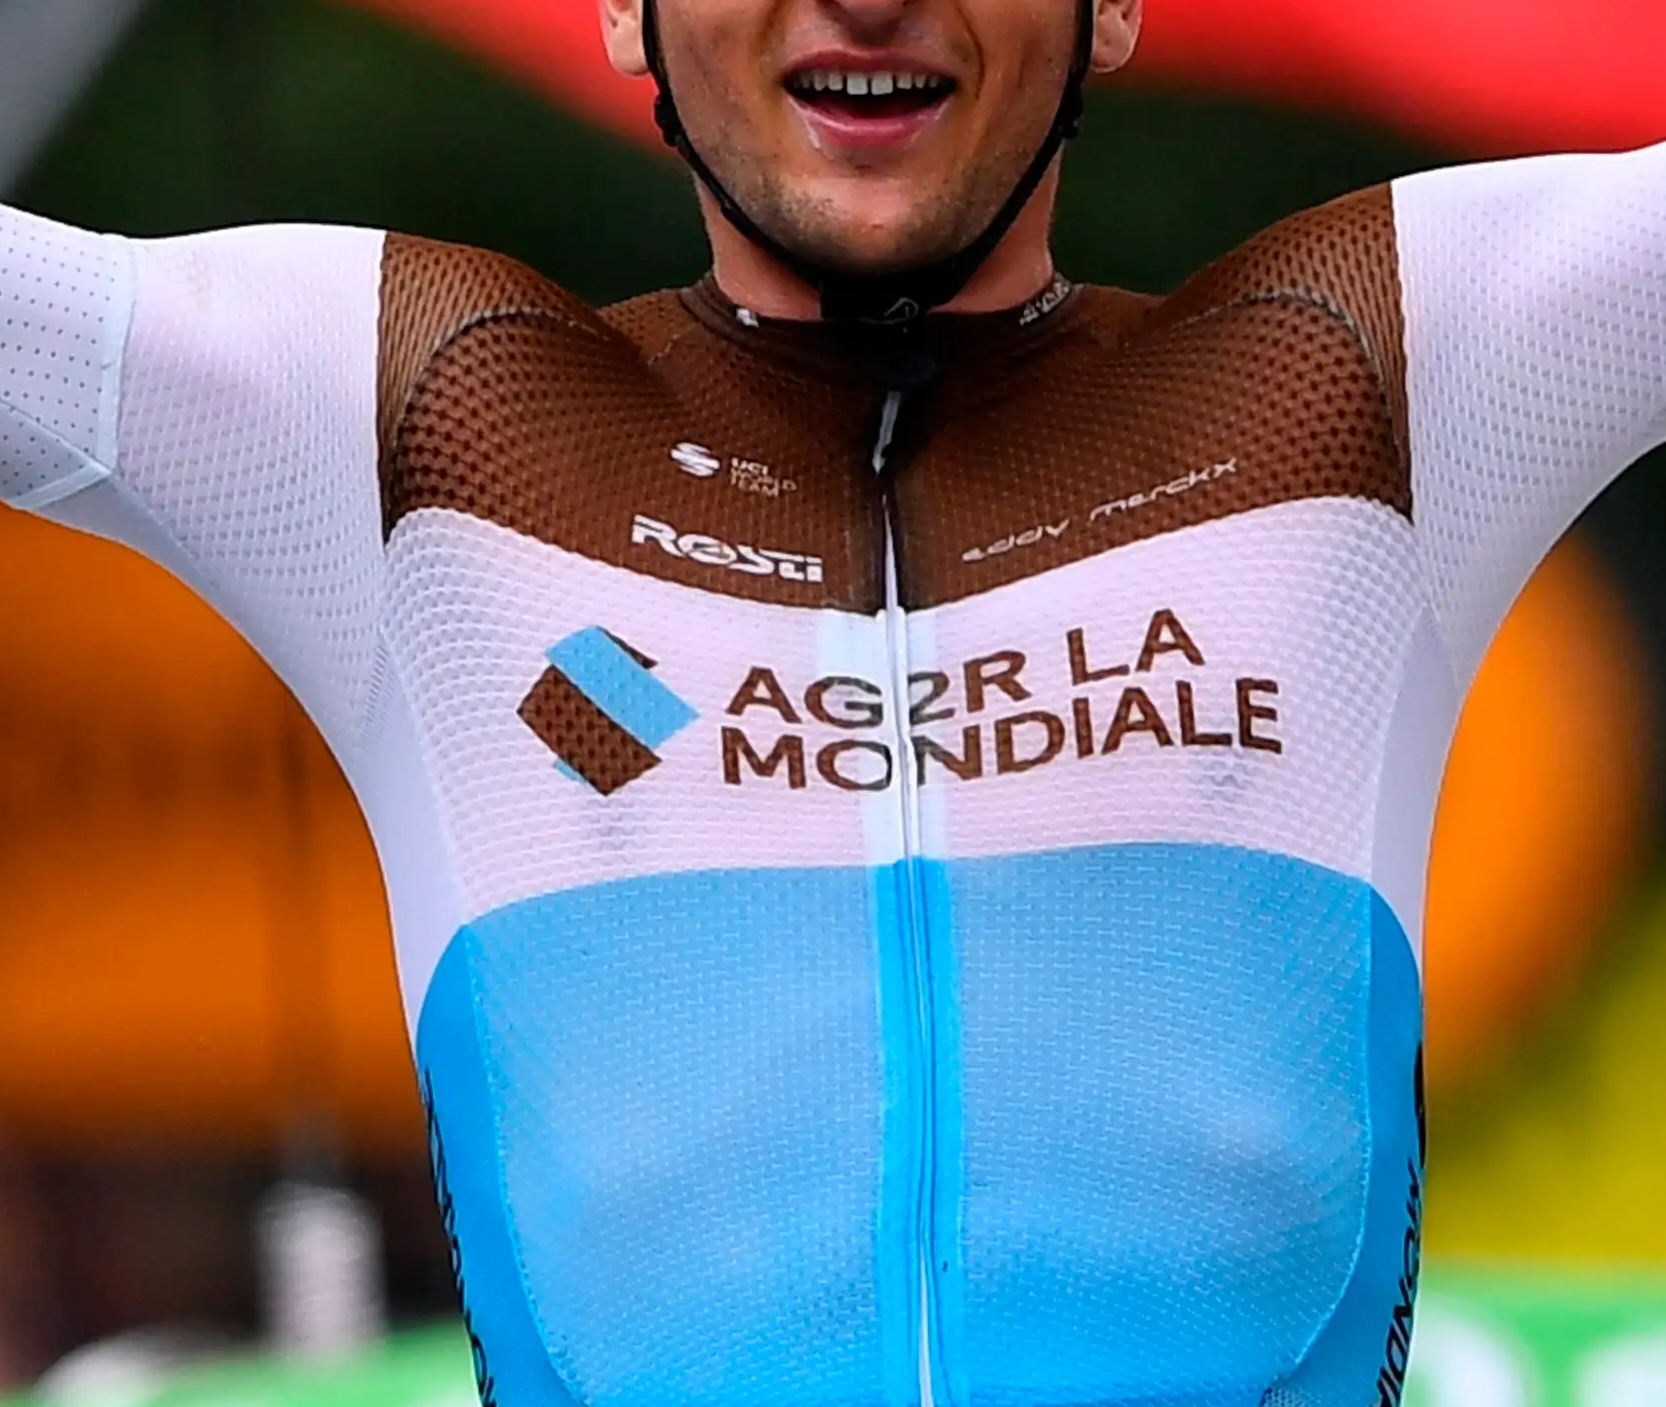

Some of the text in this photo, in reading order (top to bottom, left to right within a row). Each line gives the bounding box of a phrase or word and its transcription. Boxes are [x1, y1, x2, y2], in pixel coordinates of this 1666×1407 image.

[725, 608, 1205, 729] AG2R LA
[720, 678, 1284, 791] MONDIALE
